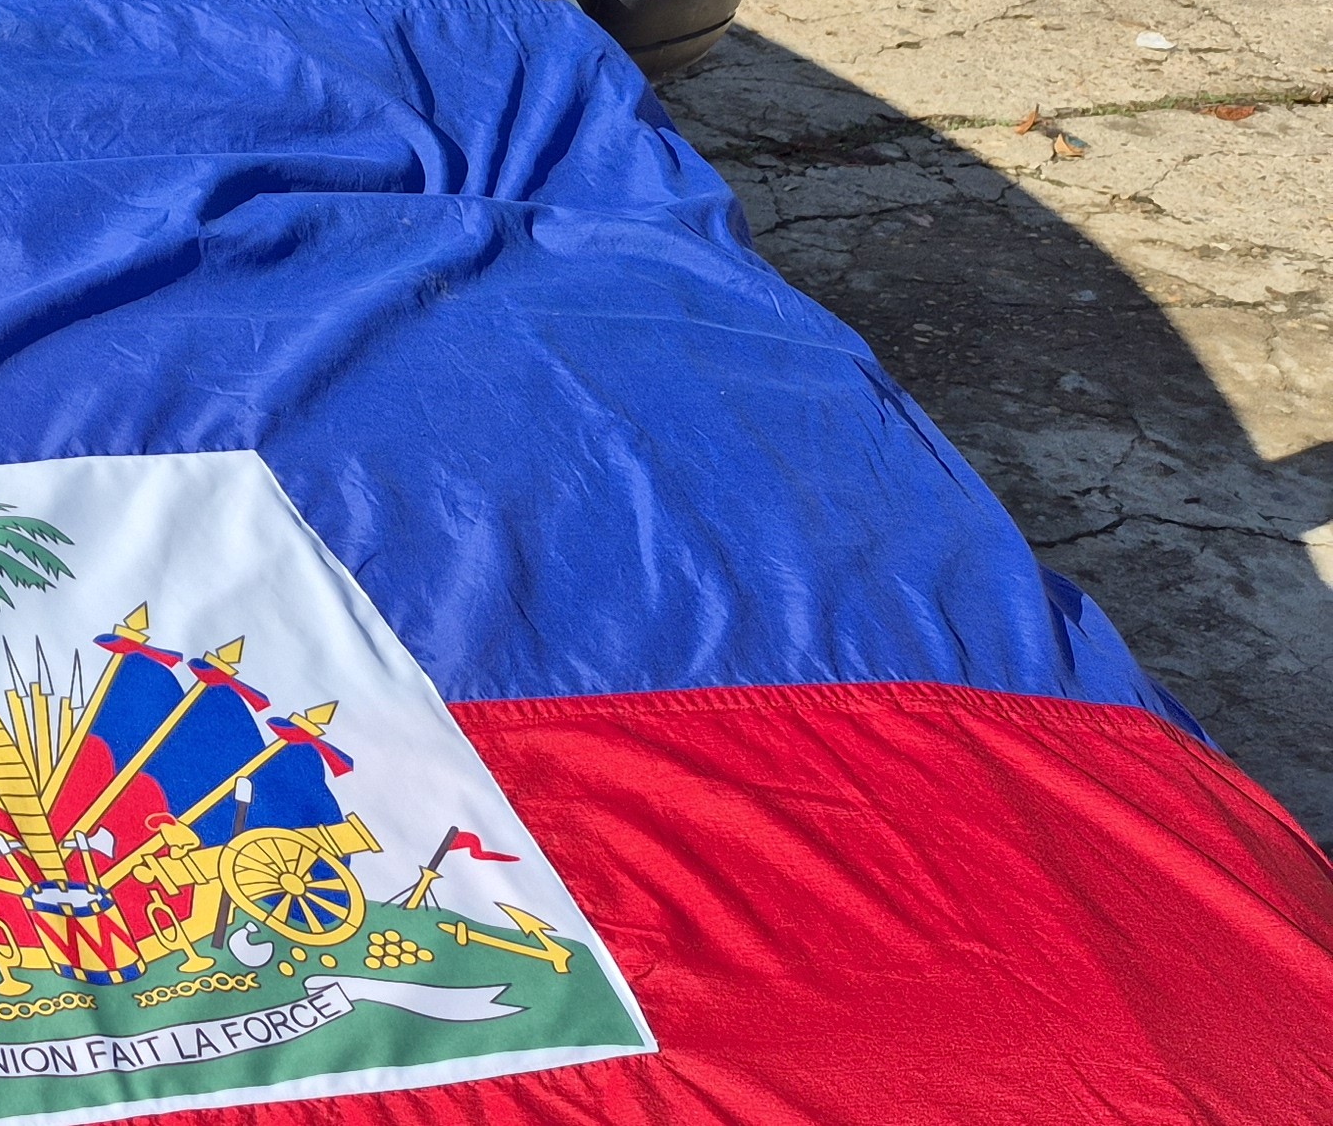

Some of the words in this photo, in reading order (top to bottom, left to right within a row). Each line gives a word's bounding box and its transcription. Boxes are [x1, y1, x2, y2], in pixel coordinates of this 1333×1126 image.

[88, 1037, 162, 1069] FAIT
[169, 1032, 218, 1060] LA
[220, 993, 343, 1050] FORCE
